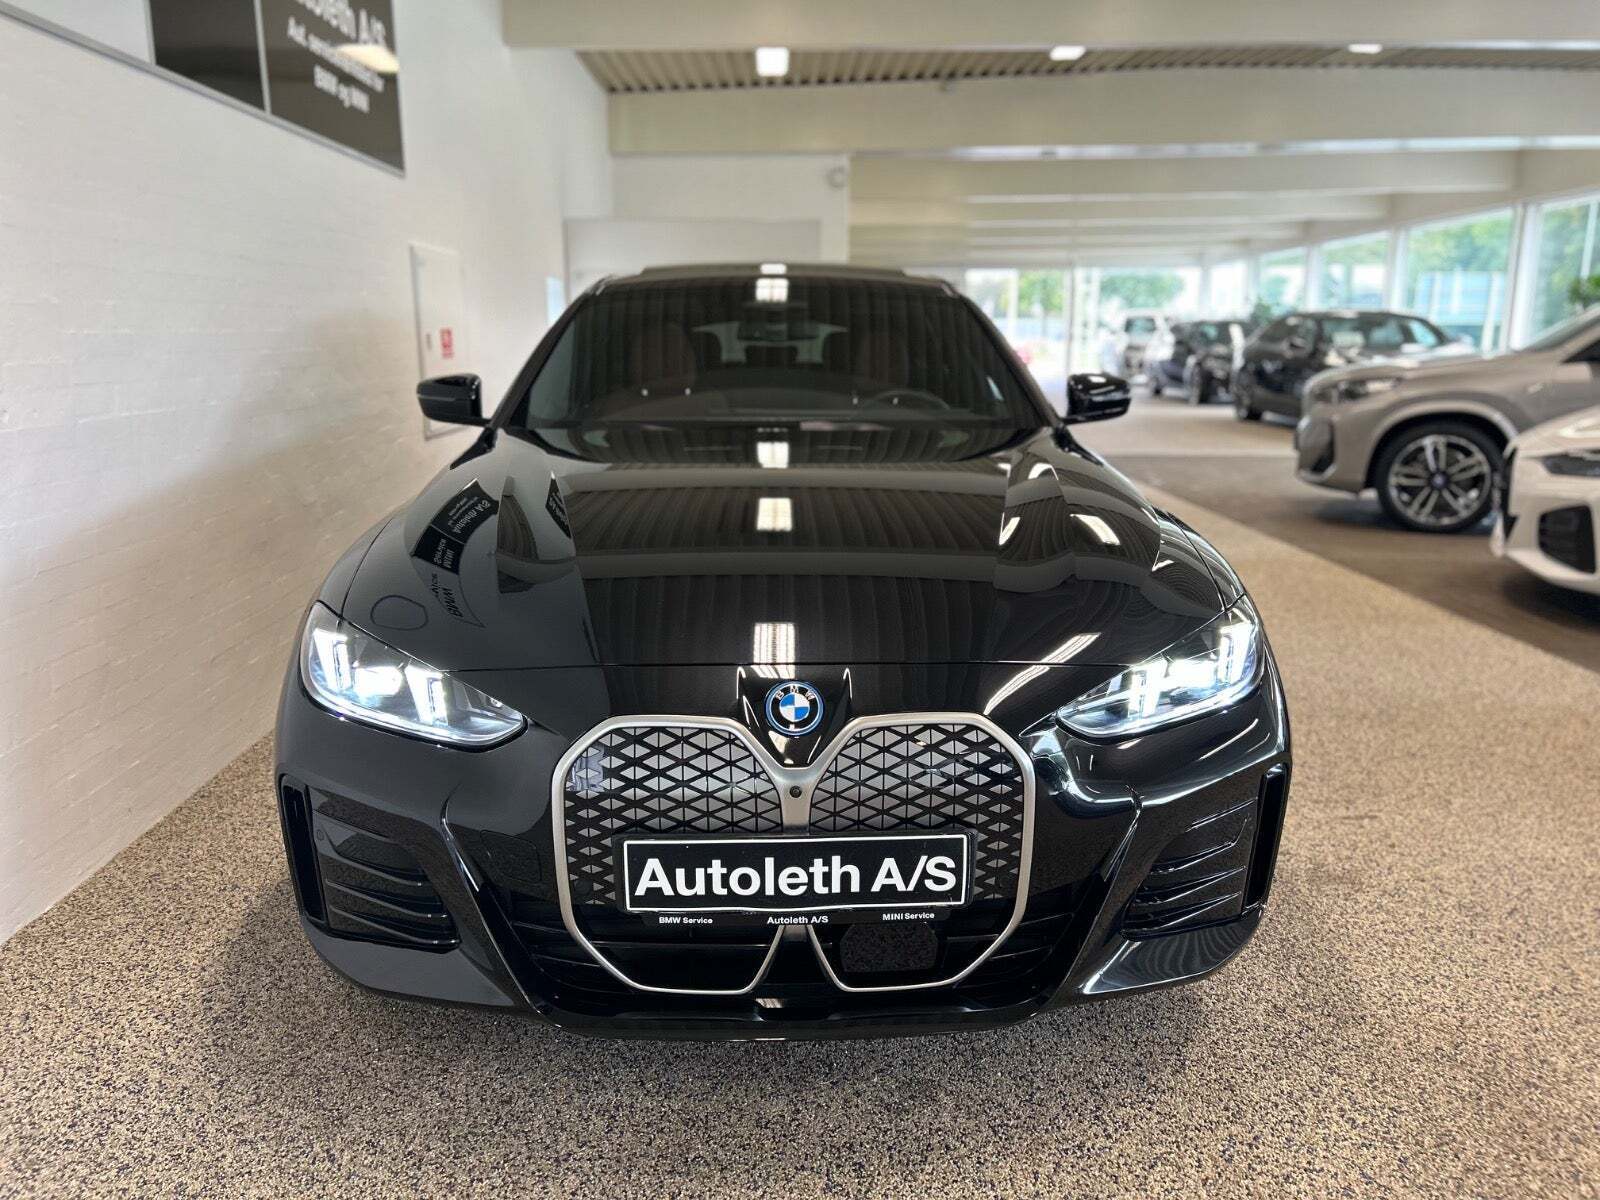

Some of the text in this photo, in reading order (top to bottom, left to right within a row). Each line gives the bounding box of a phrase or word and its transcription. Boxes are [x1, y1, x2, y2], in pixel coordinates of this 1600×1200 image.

[634, 855, 957, 896] Autoleth A/S
[658, 916, 714, 925] BMW Service
[766, 915, 830, 925] Autoleth A/S
[882, 911, 936, 921] MINI Service
